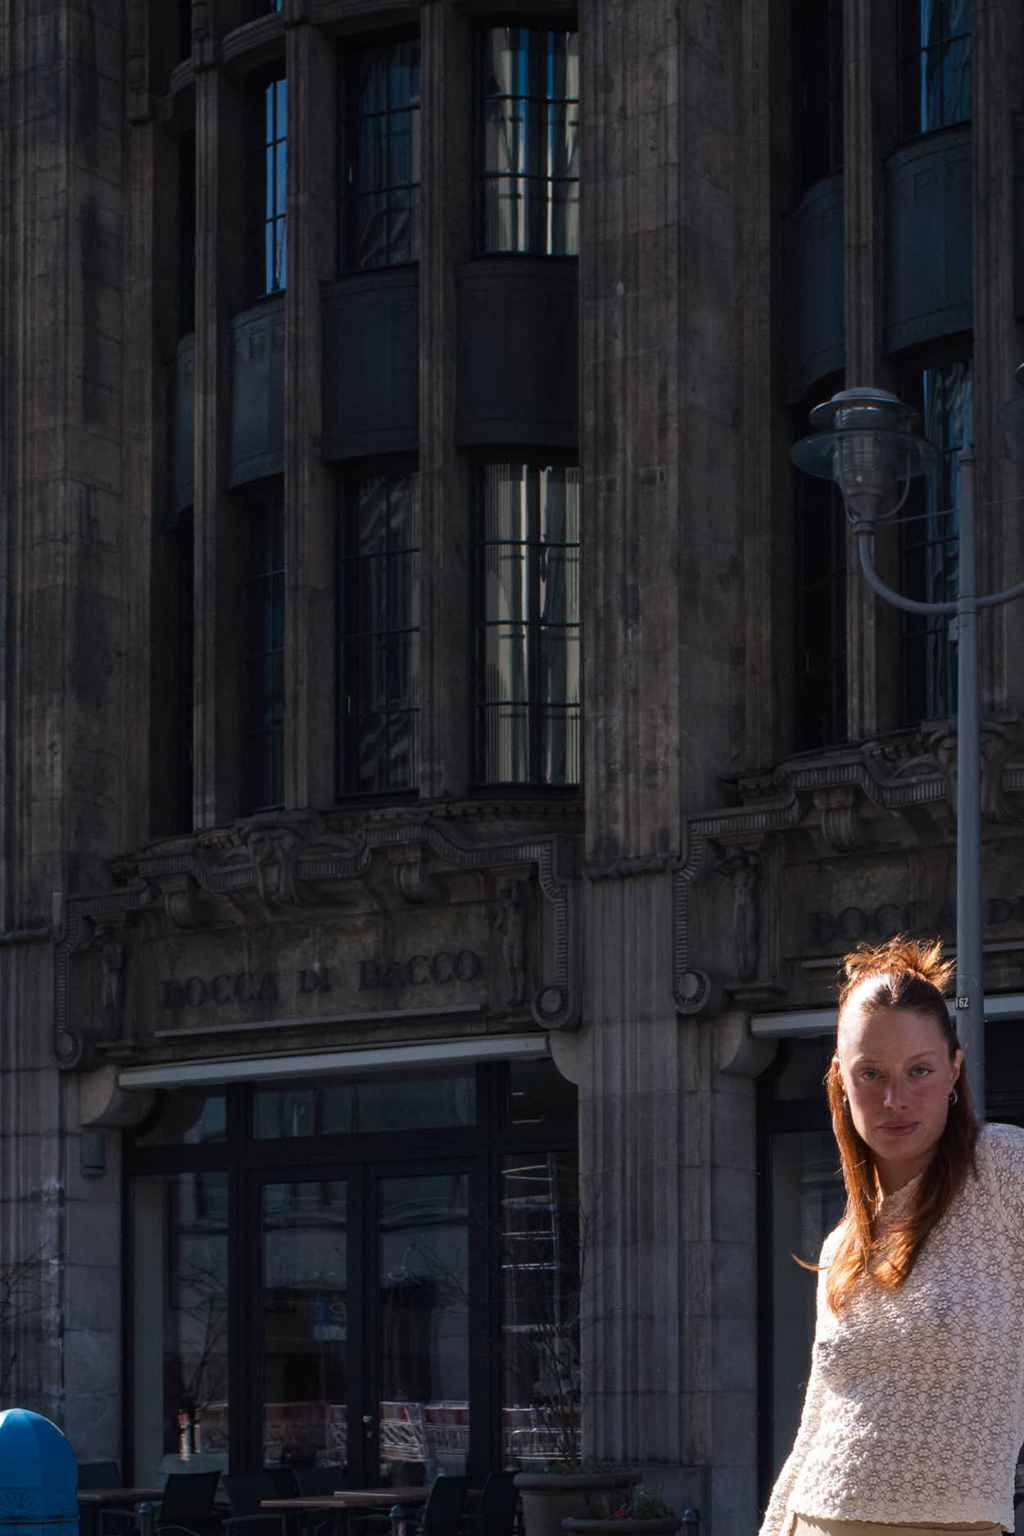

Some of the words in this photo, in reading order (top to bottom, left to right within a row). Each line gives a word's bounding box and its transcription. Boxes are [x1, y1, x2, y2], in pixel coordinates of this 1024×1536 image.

[986, 896, 1024, 926] DI
[159, 971, 278, 1009] BOCCA
[297, 968, 330, 993] DI
[355, 949, 482, 992] BACCO
